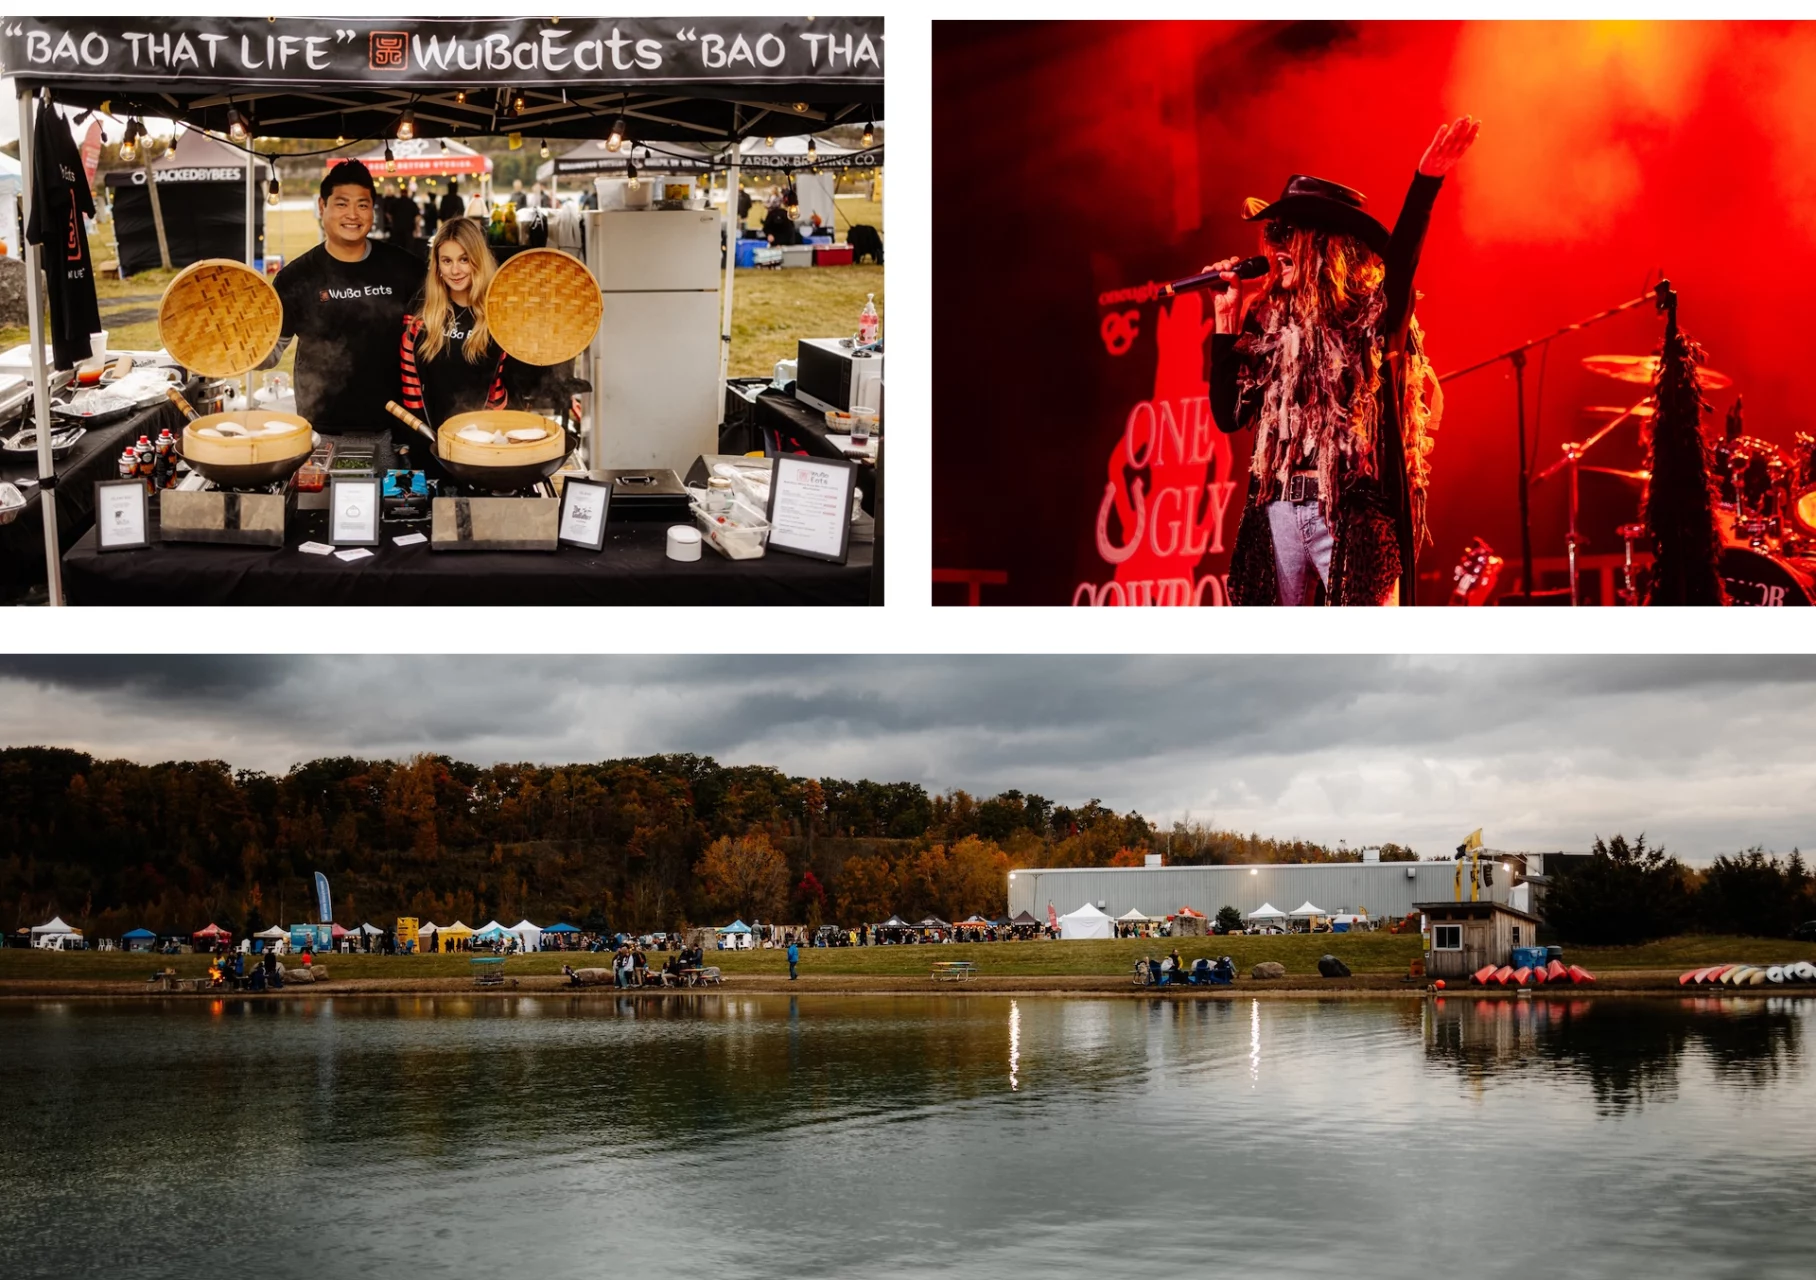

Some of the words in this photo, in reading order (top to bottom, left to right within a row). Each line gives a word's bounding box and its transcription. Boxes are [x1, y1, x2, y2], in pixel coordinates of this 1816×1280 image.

[121, 31, 229, 68] THAT
[412, 27, 663, 70] WuBaEats
[799, 33, 884, 69] THA
[328, 288, 361, 299] WuBa
[364, 285, 393, 296] Eats
[1126, 397, 1215, 469] ONE
[1096, 477, 1237, 565] UGLY
